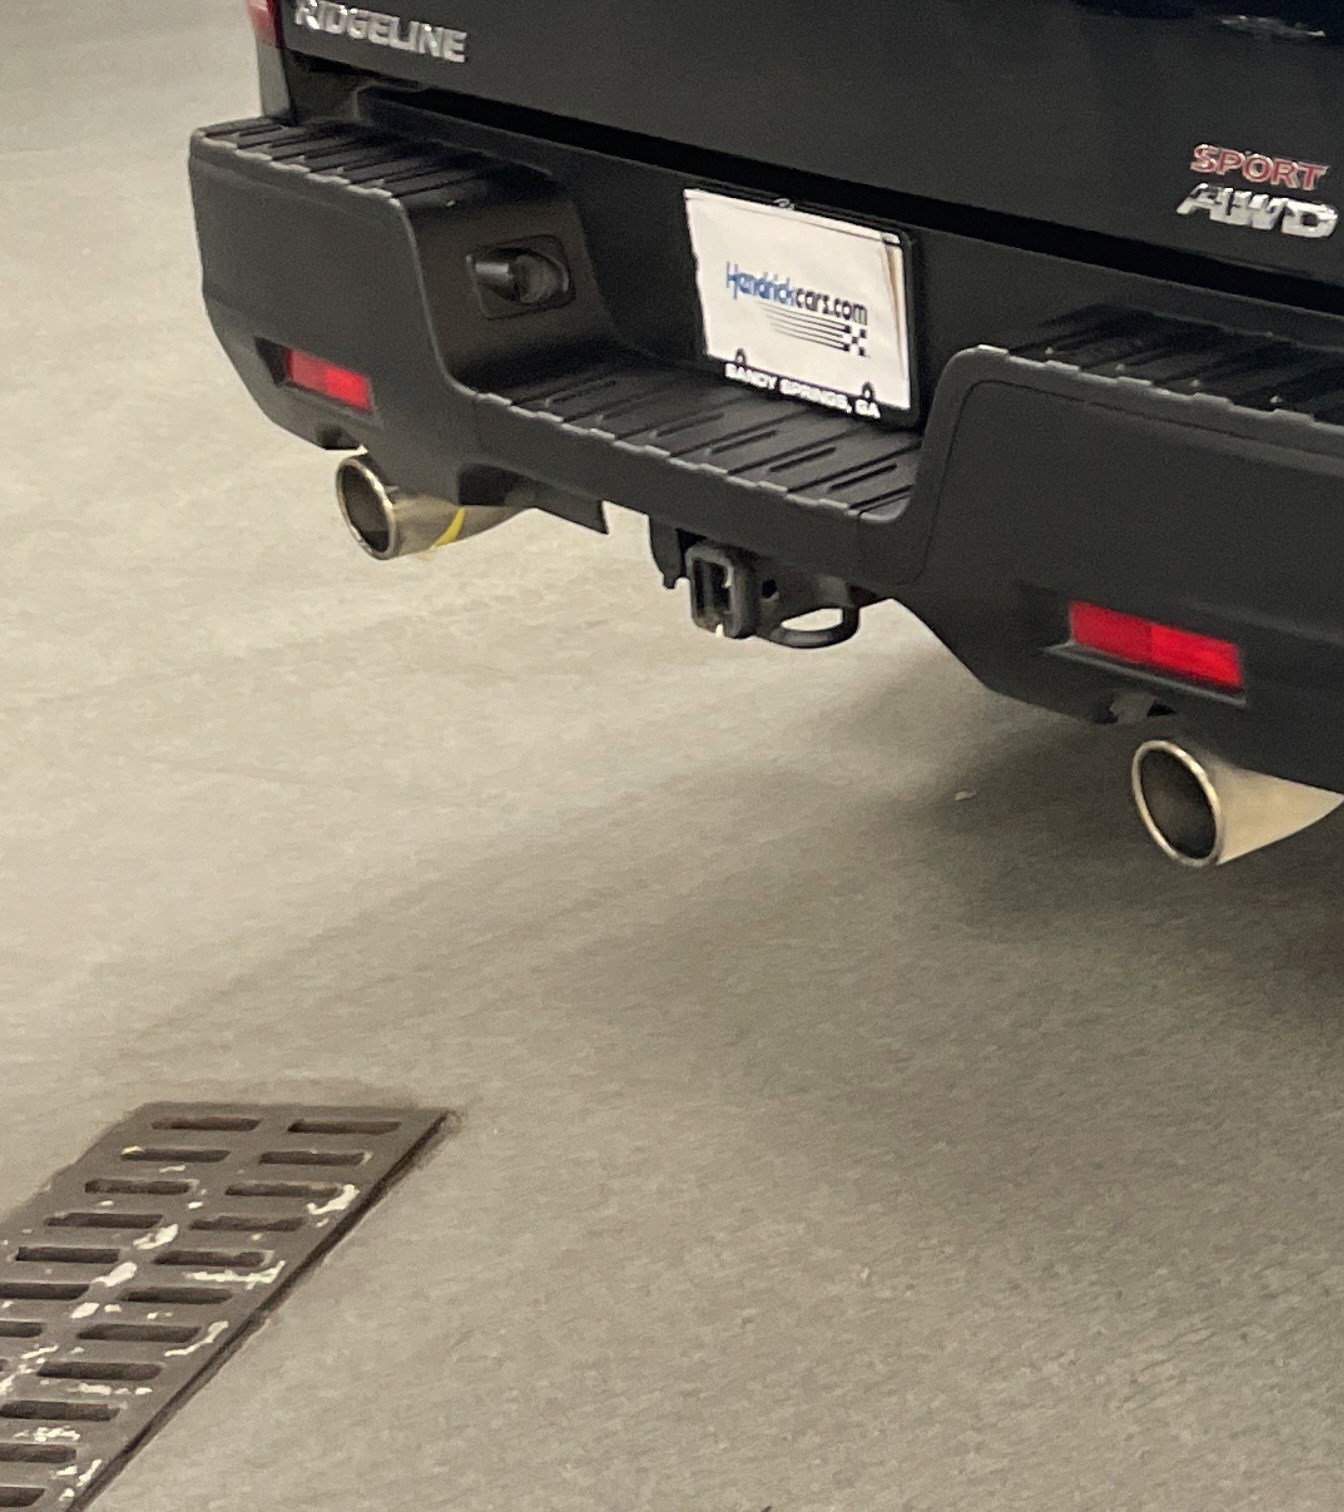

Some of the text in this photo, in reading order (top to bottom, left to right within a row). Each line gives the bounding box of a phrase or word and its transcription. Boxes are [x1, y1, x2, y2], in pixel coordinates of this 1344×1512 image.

[1190, 144, 1331, 191] SPORT
[1176, 182, 1338, 238] AWD
[725, 261, 868, 326] Hendrickcars.com
